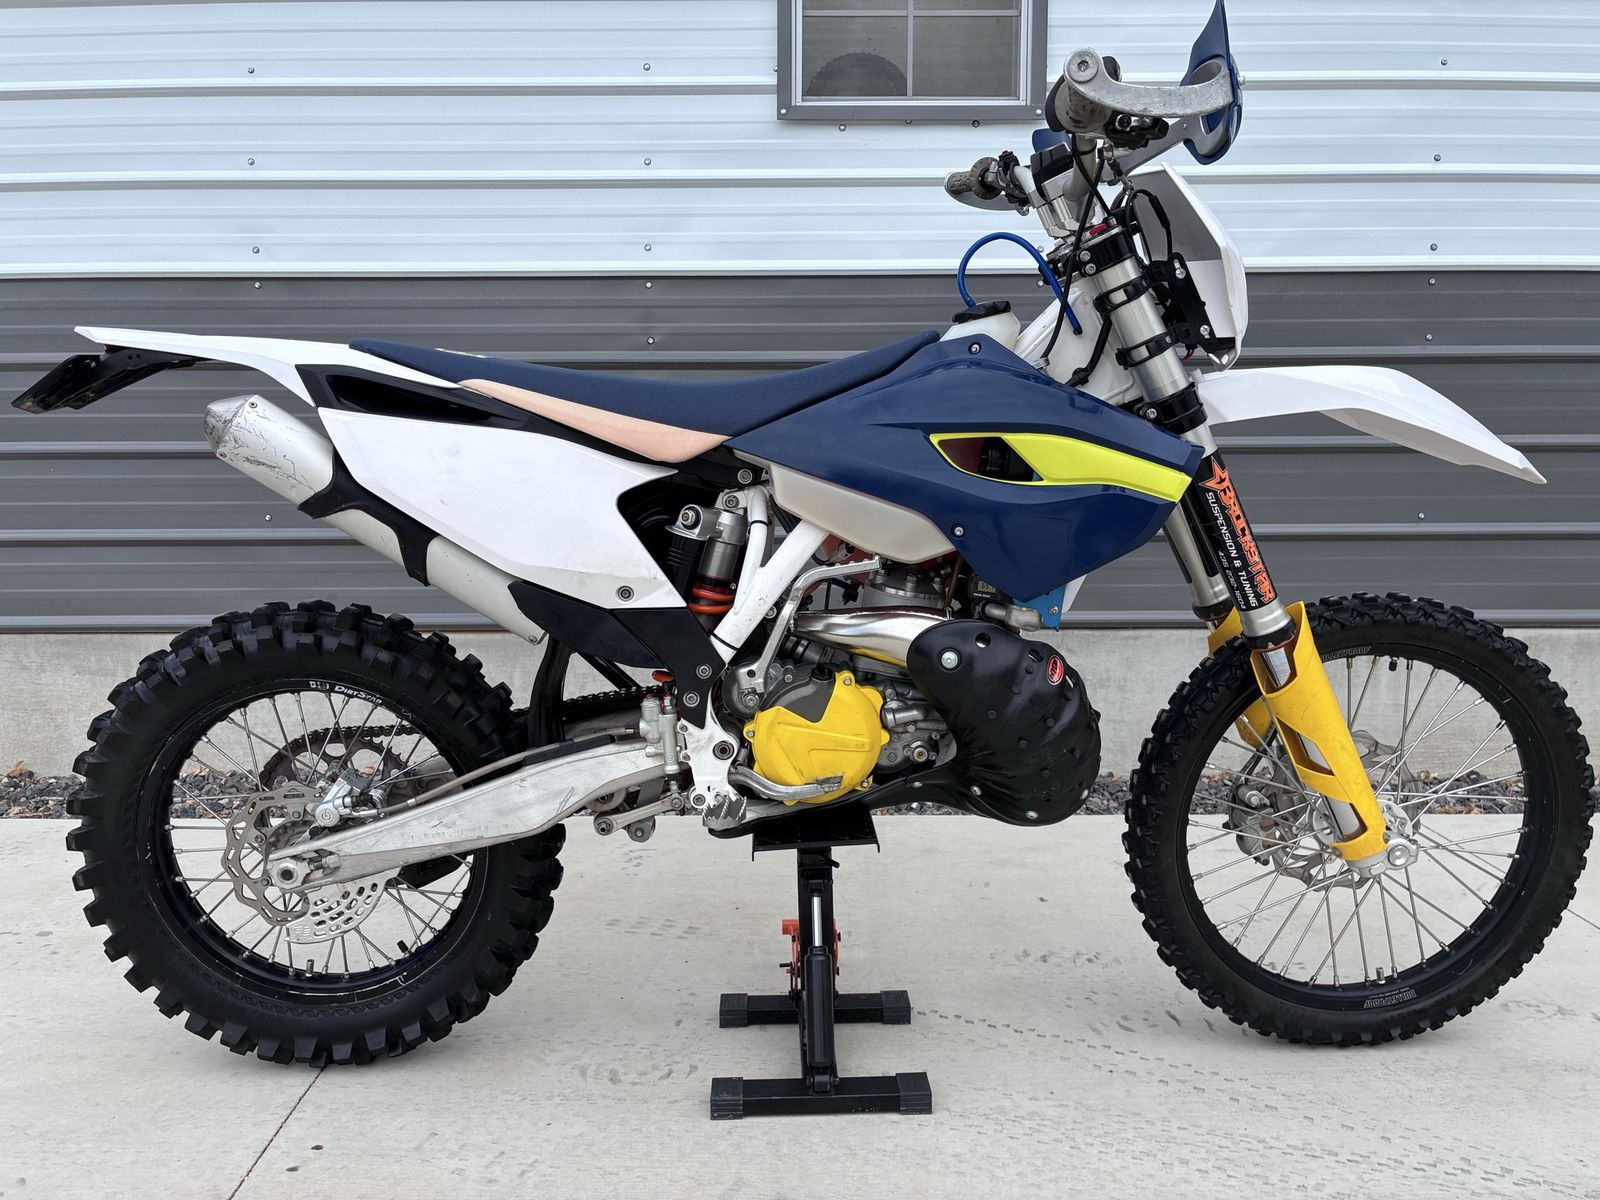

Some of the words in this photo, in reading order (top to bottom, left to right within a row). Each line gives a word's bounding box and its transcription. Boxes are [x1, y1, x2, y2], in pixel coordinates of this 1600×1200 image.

[1206, 492, 1238, 558] SUSPENSION
[1233, 559, 1243, 568] &
[1238, 570, 1259, 607] TUNING
[1217, 470, 1275, 603] BROCKSTAR
